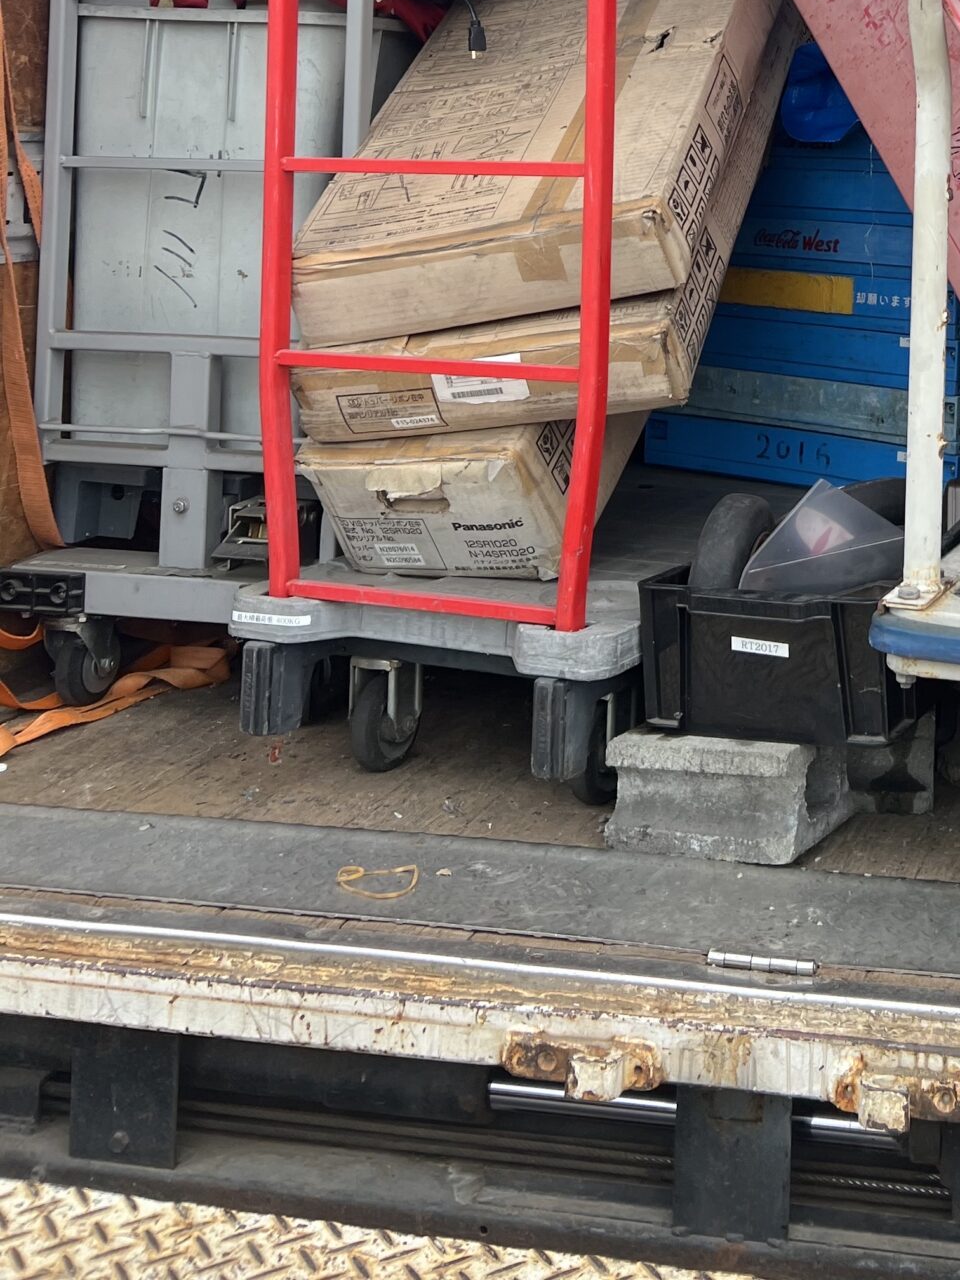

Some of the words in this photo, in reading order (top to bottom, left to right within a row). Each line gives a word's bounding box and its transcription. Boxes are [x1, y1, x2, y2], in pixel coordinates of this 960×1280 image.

[802, 228, 840, 253] West
[451, 518, 524, 531] Panasonic
[464, 539, 518, 549] 12SR1020
[468, 546, 536, 558] N-14SR1020
[741, 640, 779, 654] RT2017
